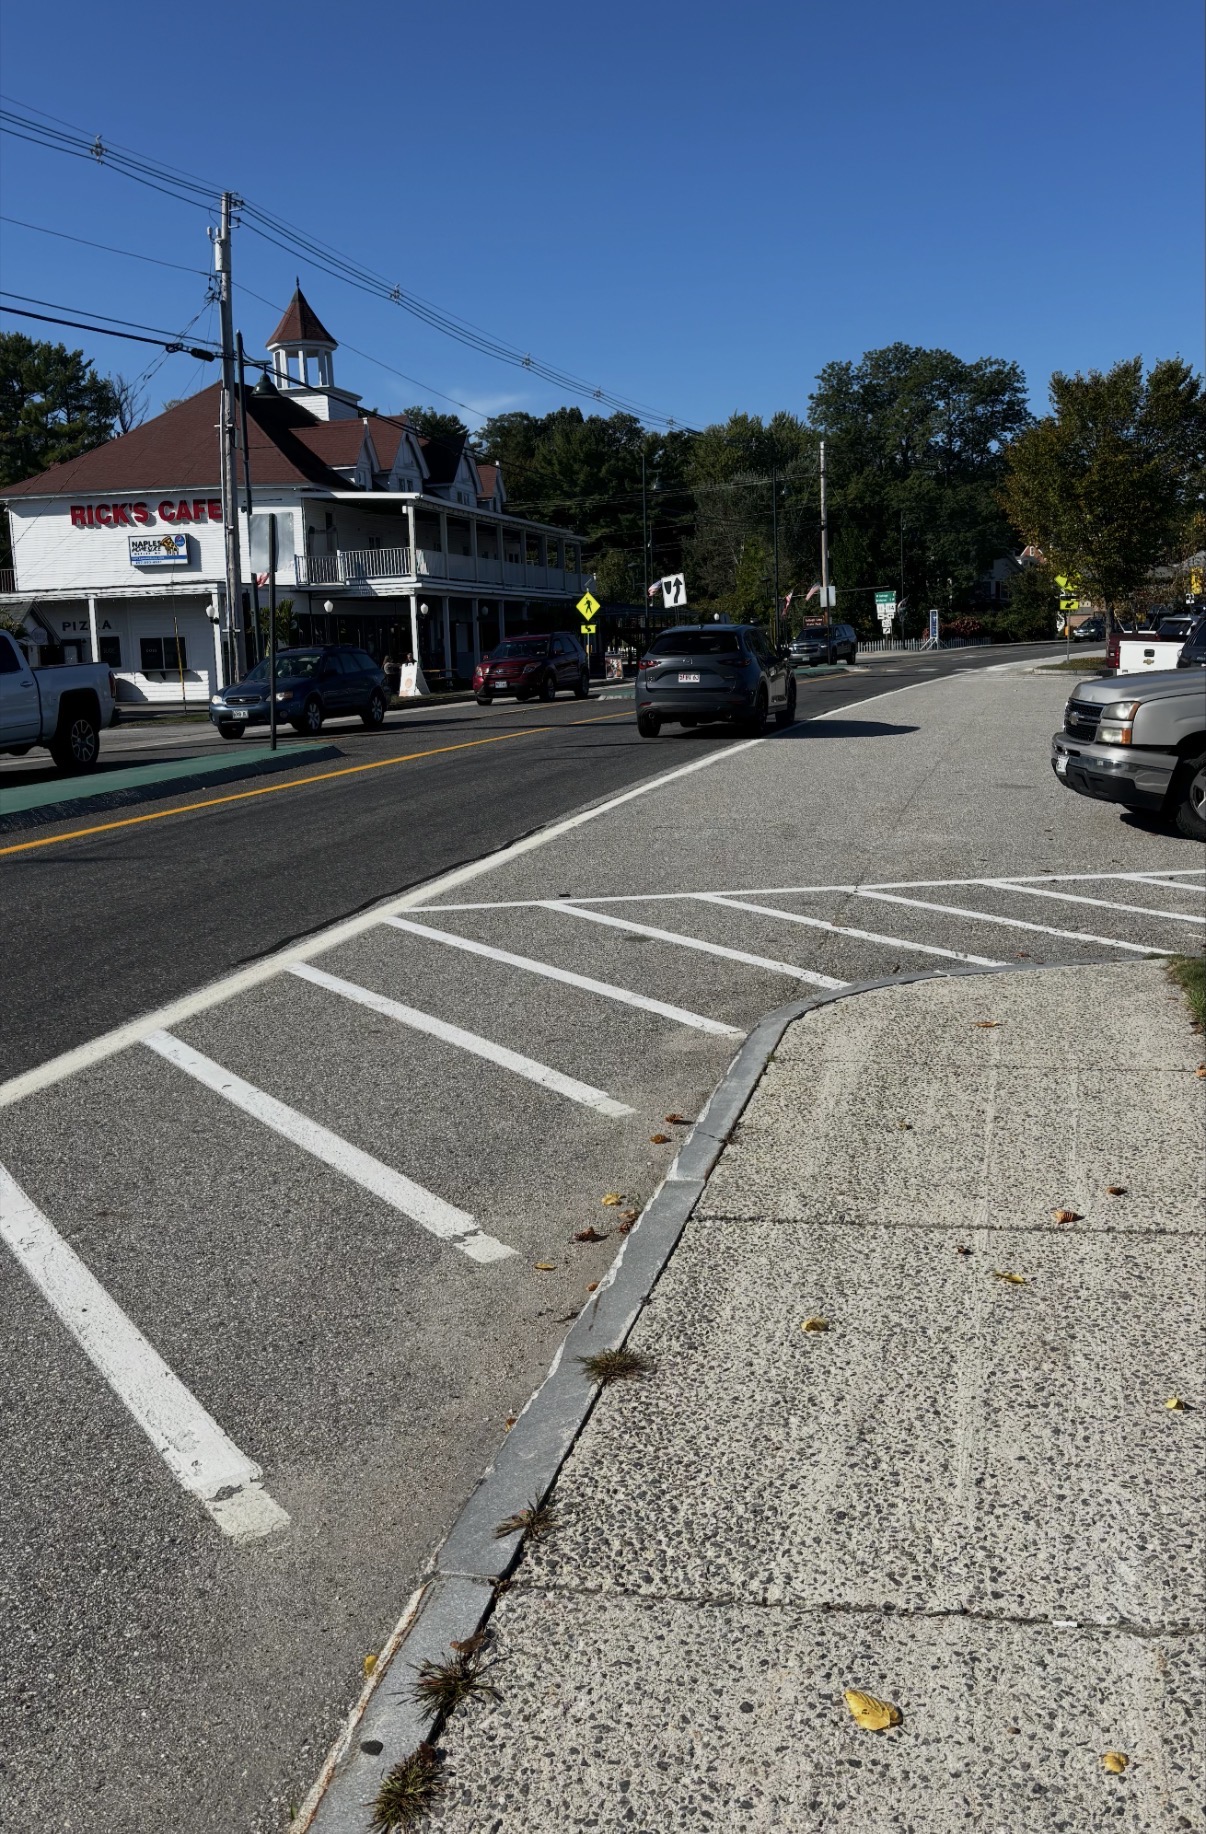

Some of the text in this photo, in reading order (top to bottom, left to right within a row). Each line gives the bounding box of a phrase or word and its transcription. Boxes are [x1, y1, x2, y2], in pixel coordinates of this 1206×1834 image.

[70, 498, 223, 526] RICK'S CAFE
[131, 540, 161, 548] NAPLES
[62, 620, 112, 632] PIZA
